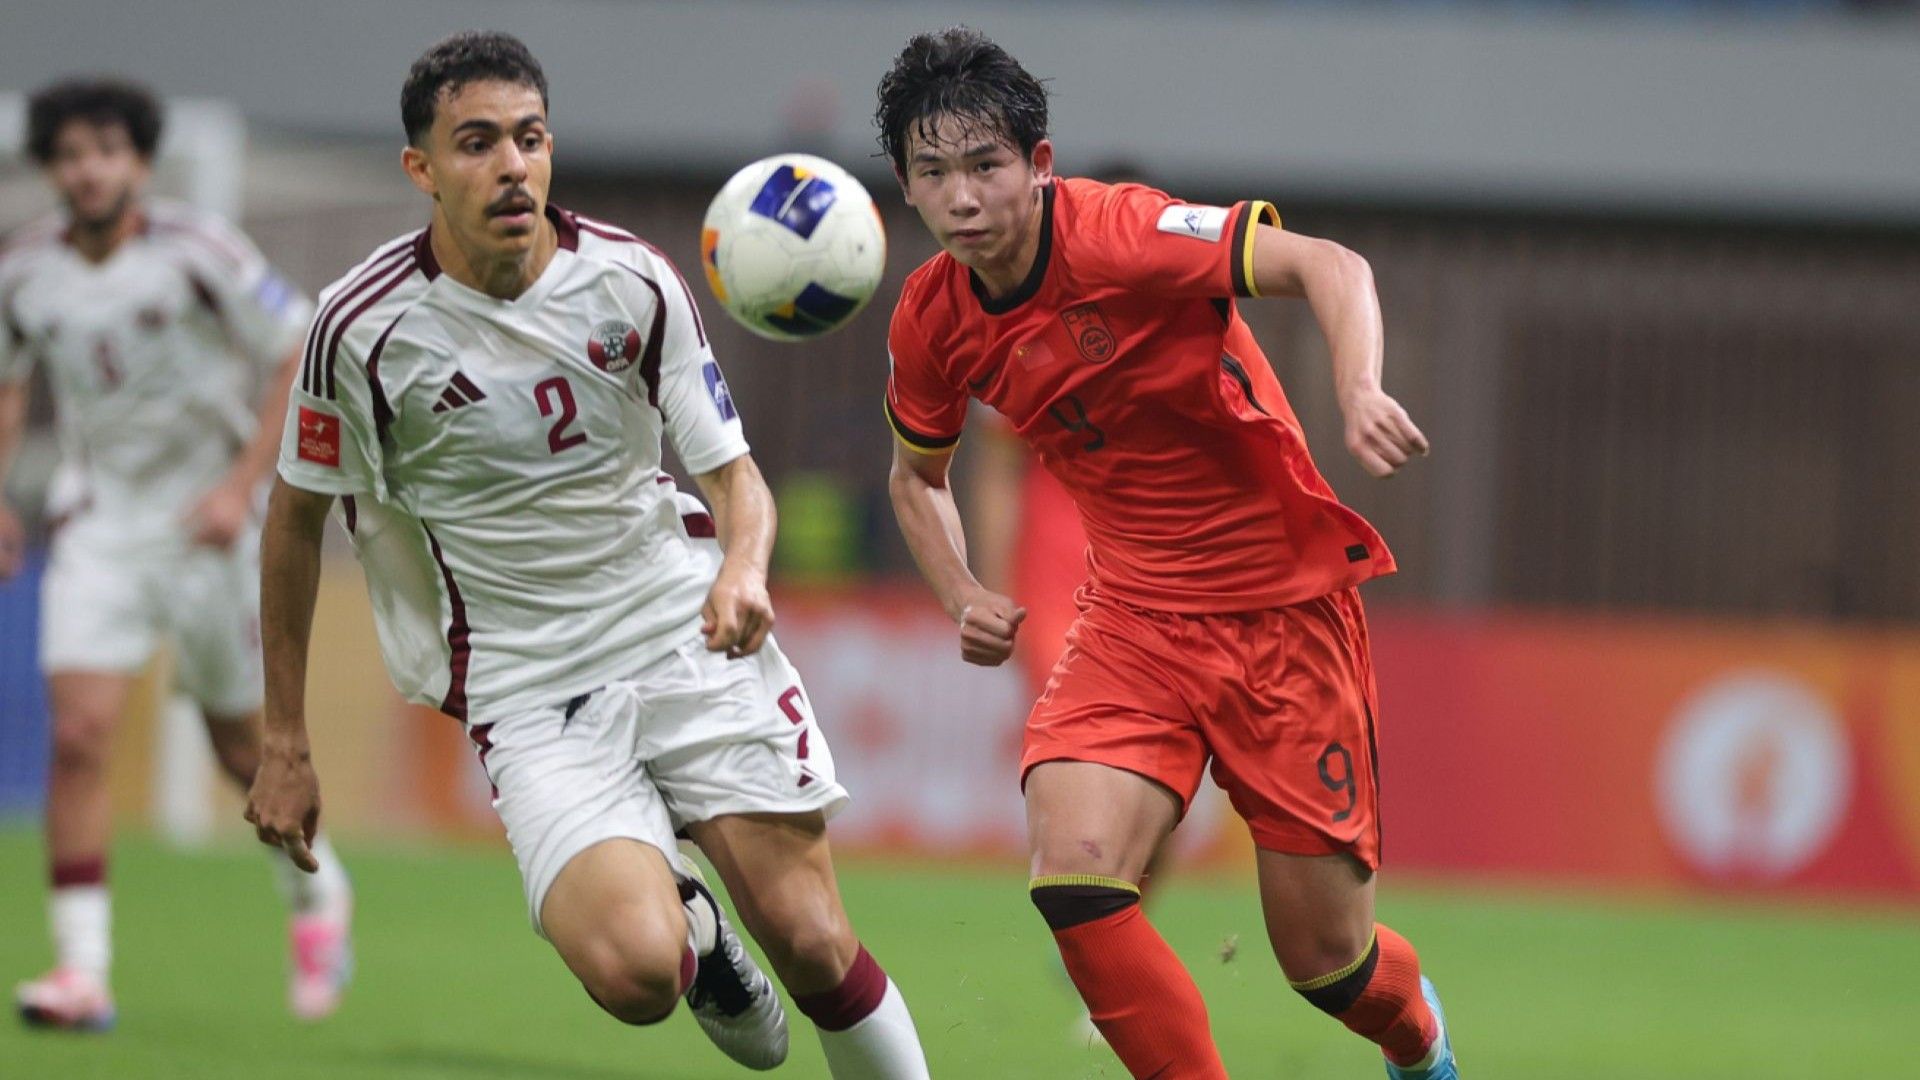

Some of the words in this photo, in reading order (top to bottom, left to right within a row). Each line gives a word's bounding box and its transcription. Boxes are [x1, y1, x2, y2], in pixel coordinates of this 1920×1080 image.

[534, 376, 587, 455] 2
[1048, 393, 1105, 453] 9
[1317, 741, 1356, 822] 9
